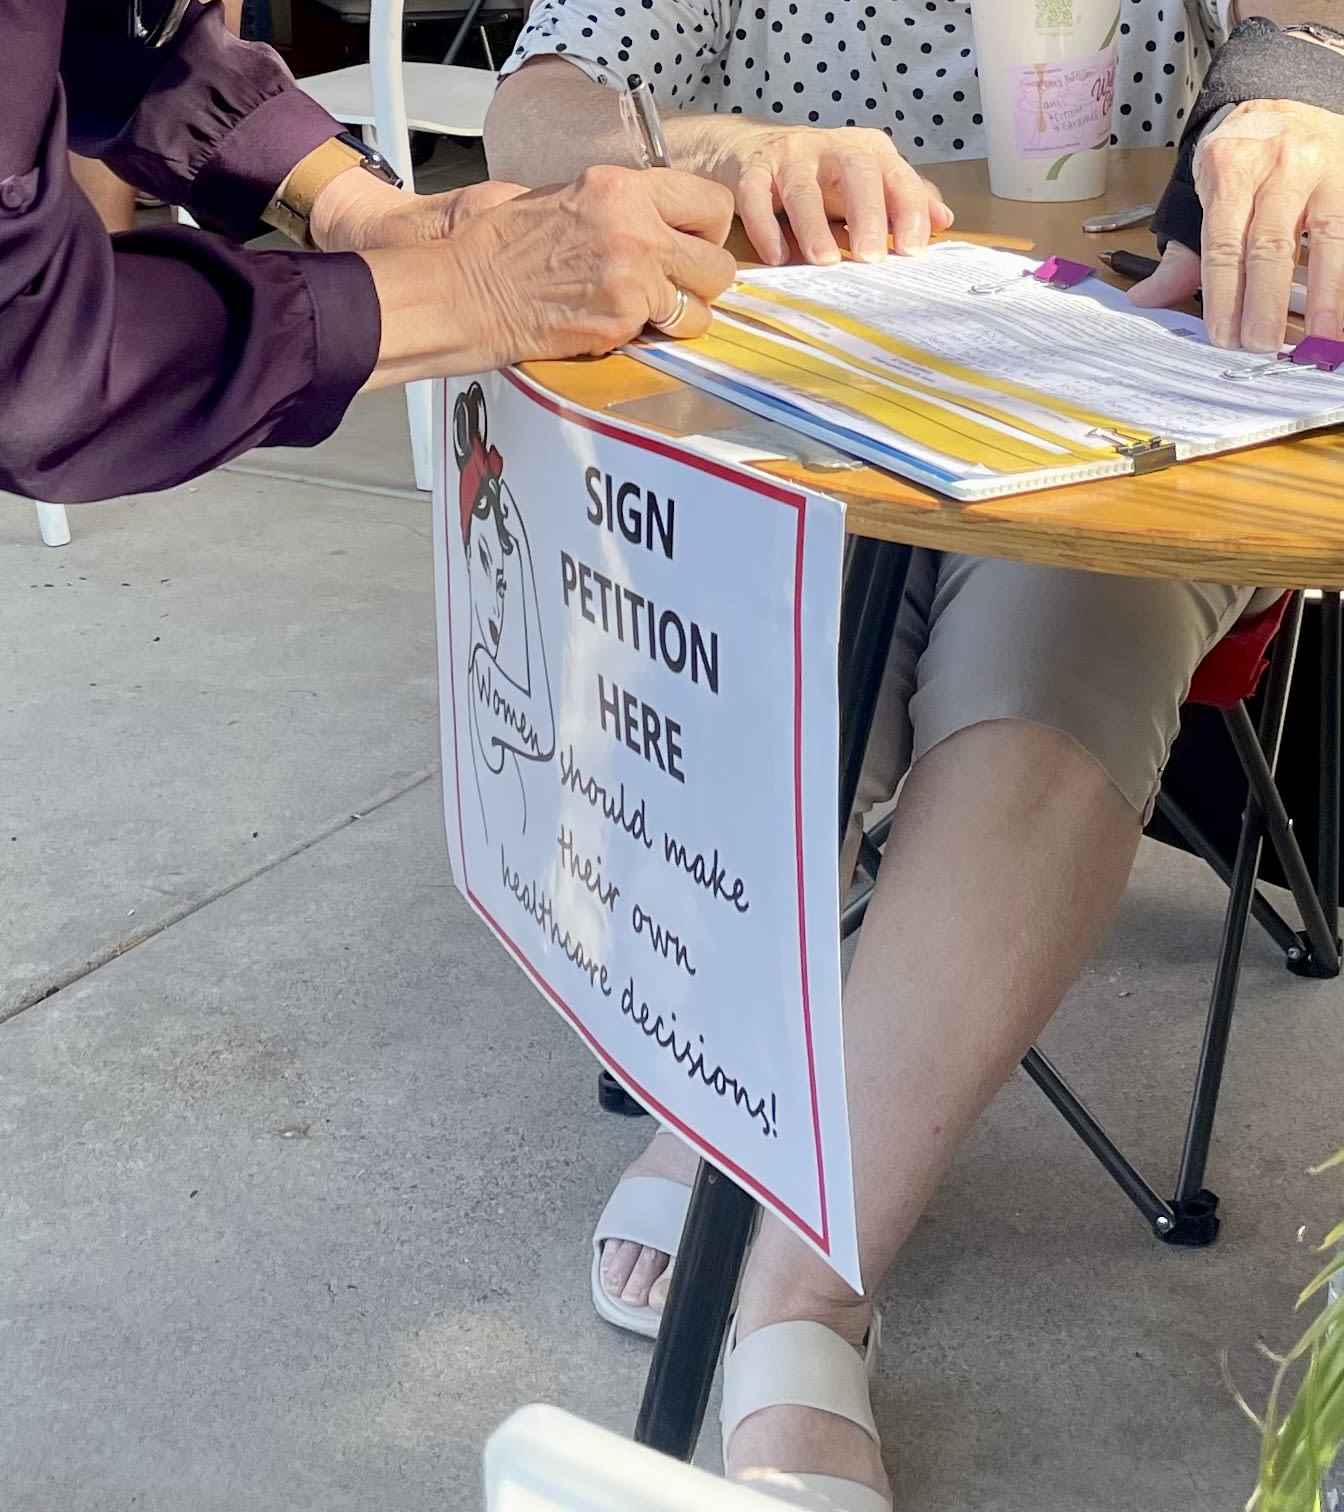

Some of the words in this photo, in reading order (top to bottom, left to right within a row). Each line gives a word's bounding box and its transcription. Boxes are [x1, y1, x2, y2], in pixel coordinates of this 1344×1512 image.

[584, 466, 676, 560] SIGN
[560, 550, 720, 695] PETITION
[475, 658, 543, 757] Women
[560, 743, 653, 849] should
[664, 832, 750, 913] make
[598, 674, 686, 784] HERE
[557, 824, 621, 913] their
[632, 903, 697, 976] own
[501, 843, 612, 997] healthcare
[621, 976, 778, 1138] decisions!
